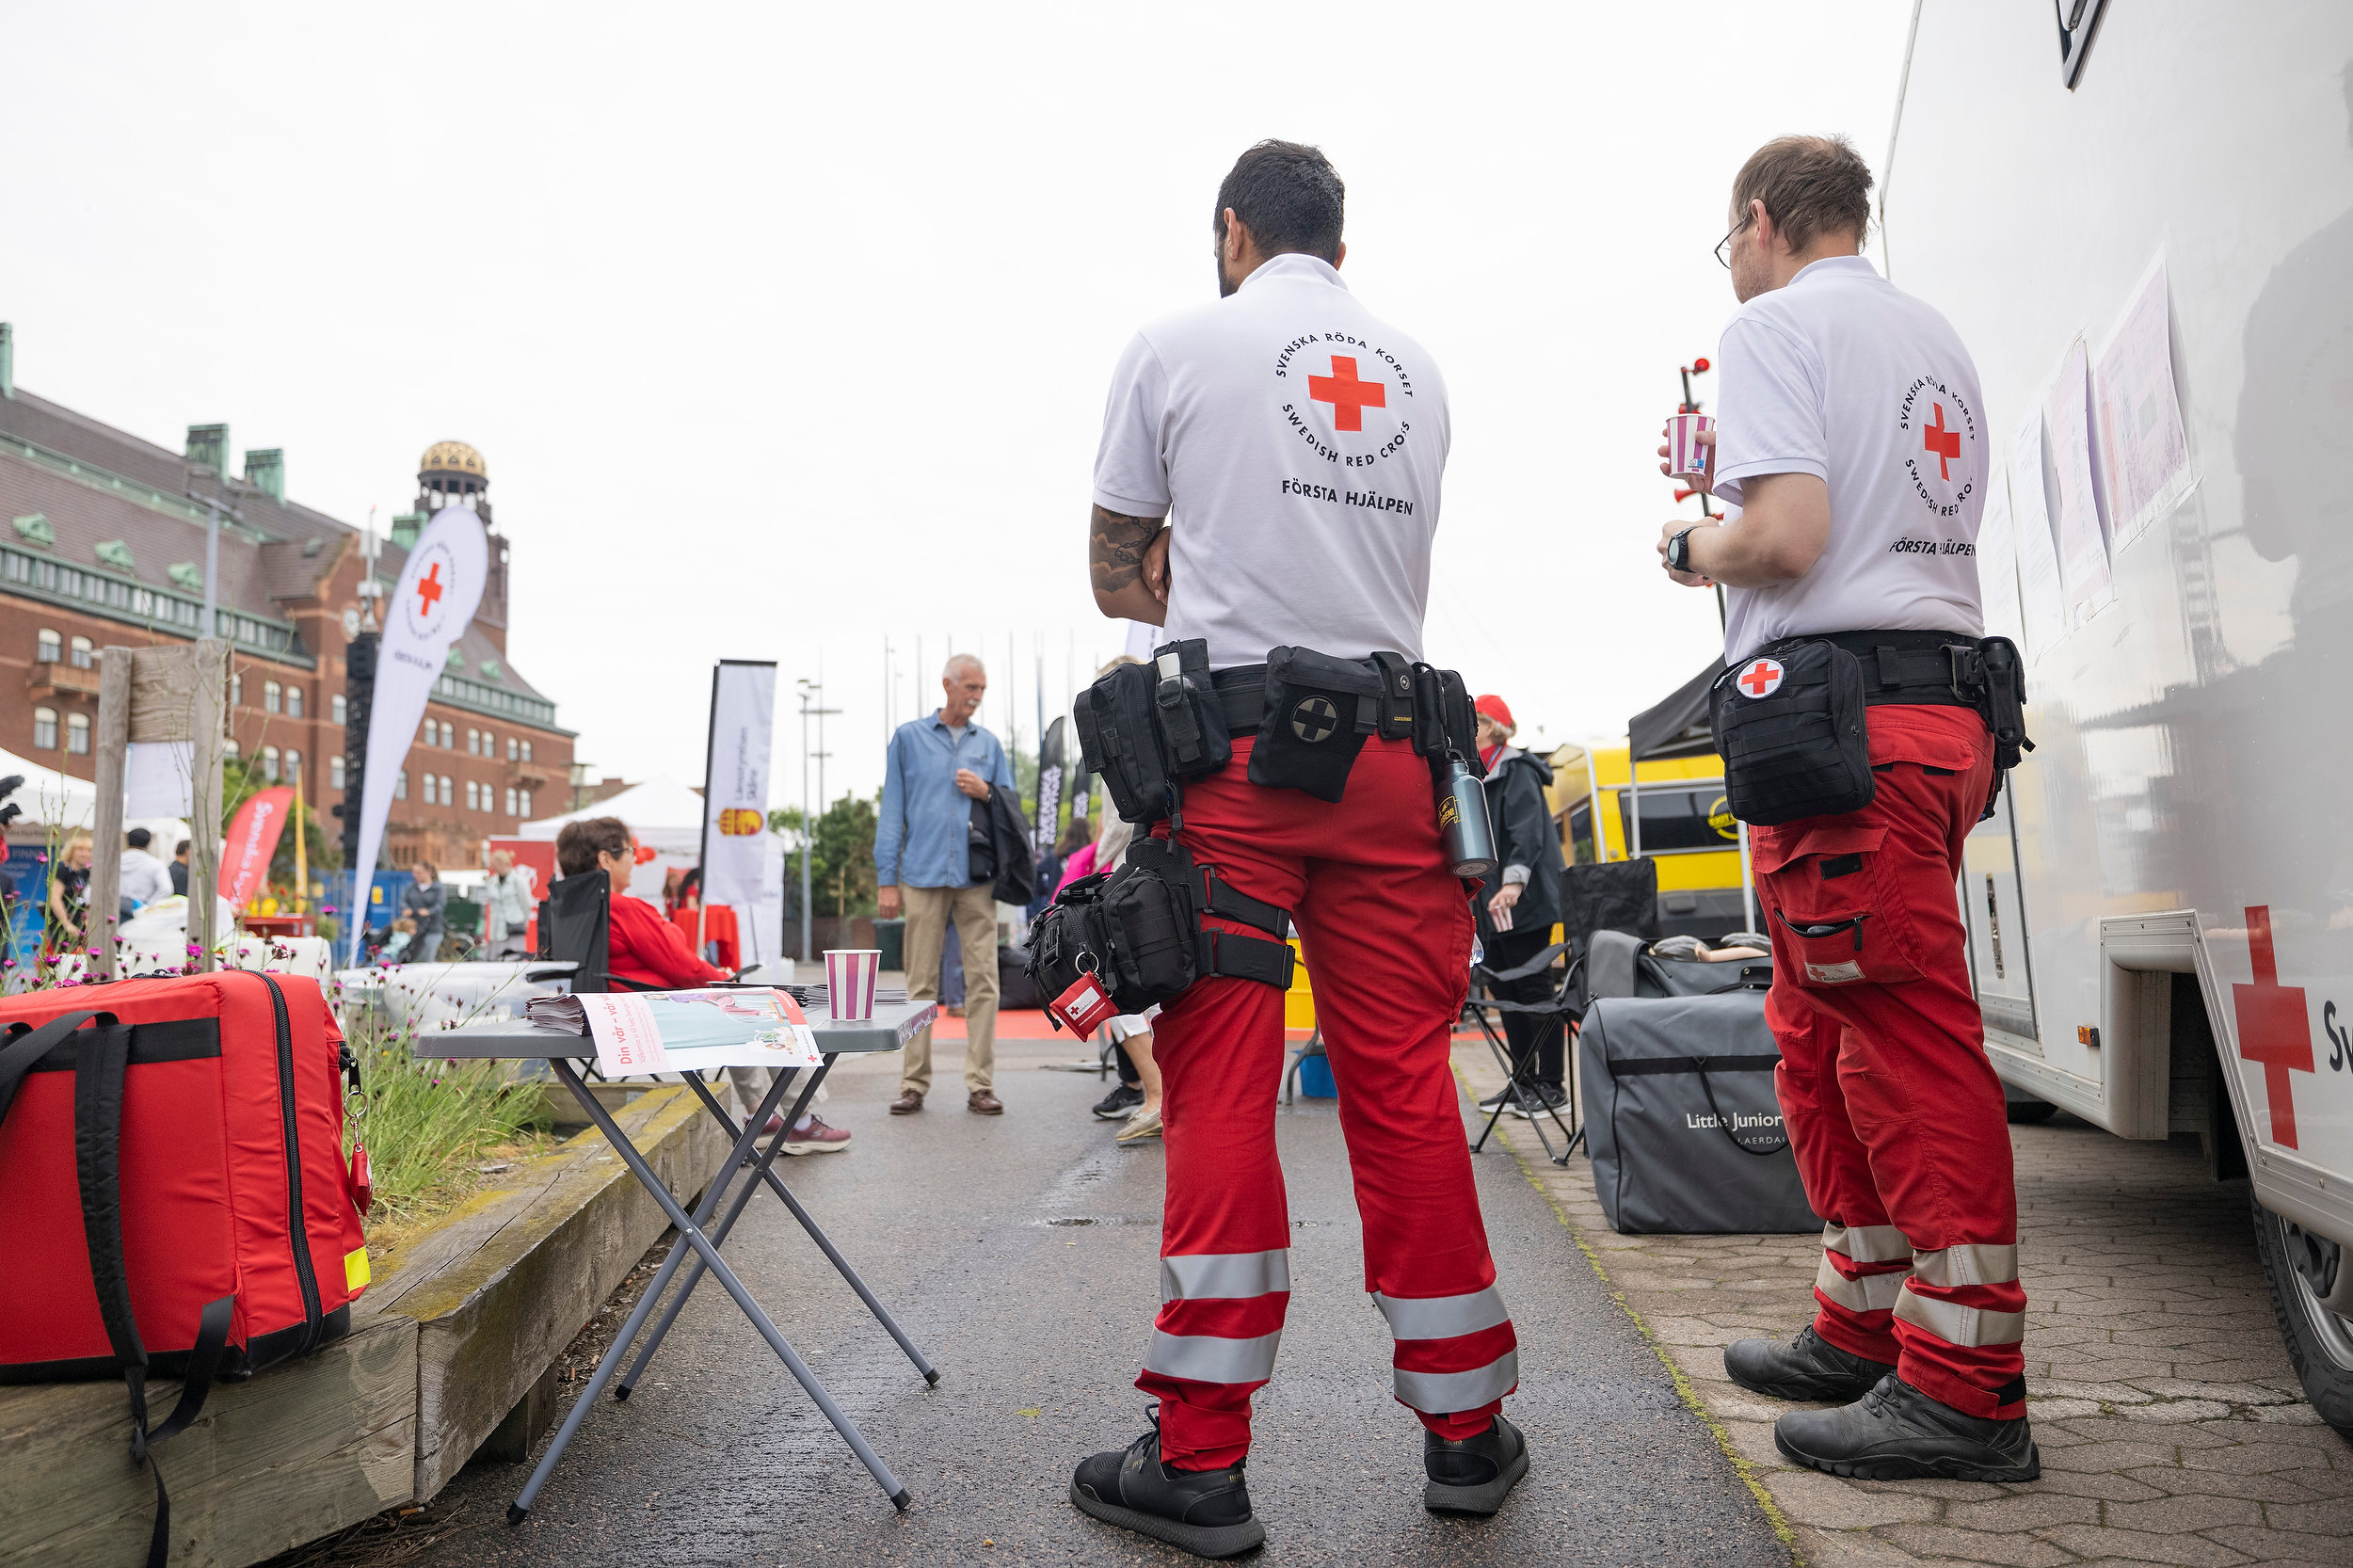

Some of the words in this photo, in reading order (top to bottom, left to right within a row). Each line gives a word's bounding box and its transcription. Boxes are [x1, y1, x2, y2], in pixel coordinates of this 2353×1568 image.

[1275, 333, 1319, 378] SVENSKA
[1324, 332, 1368, 349] RÖDA
[1375, 347, 1414, 398] KORSET
[1900, 378, 1926, 430] SVENSKA
[1925, 375, 1947, 395] RÖA
[1951, 392, 1976, 441] KORSET
[1282, 404, 1338, 463] SWEDISH
[1346, 454, 1375, 467] RED
[1282, 477, 1338, 503] FÖRSTA
[1345, 490, 1414, 516] HJÄLPEN
[1905, 458, 1939, 514] SWEDISH
[1941, 503, 1960, 517] RED
[603, 1002, 618, 1016] vår
[612, 1025, 627, 1044] vår
[617, 1047, 633, 1064] Din
[1687, 1112, 1728, 1128] Little
[1732, 1112, 1783, 1132] Junior
